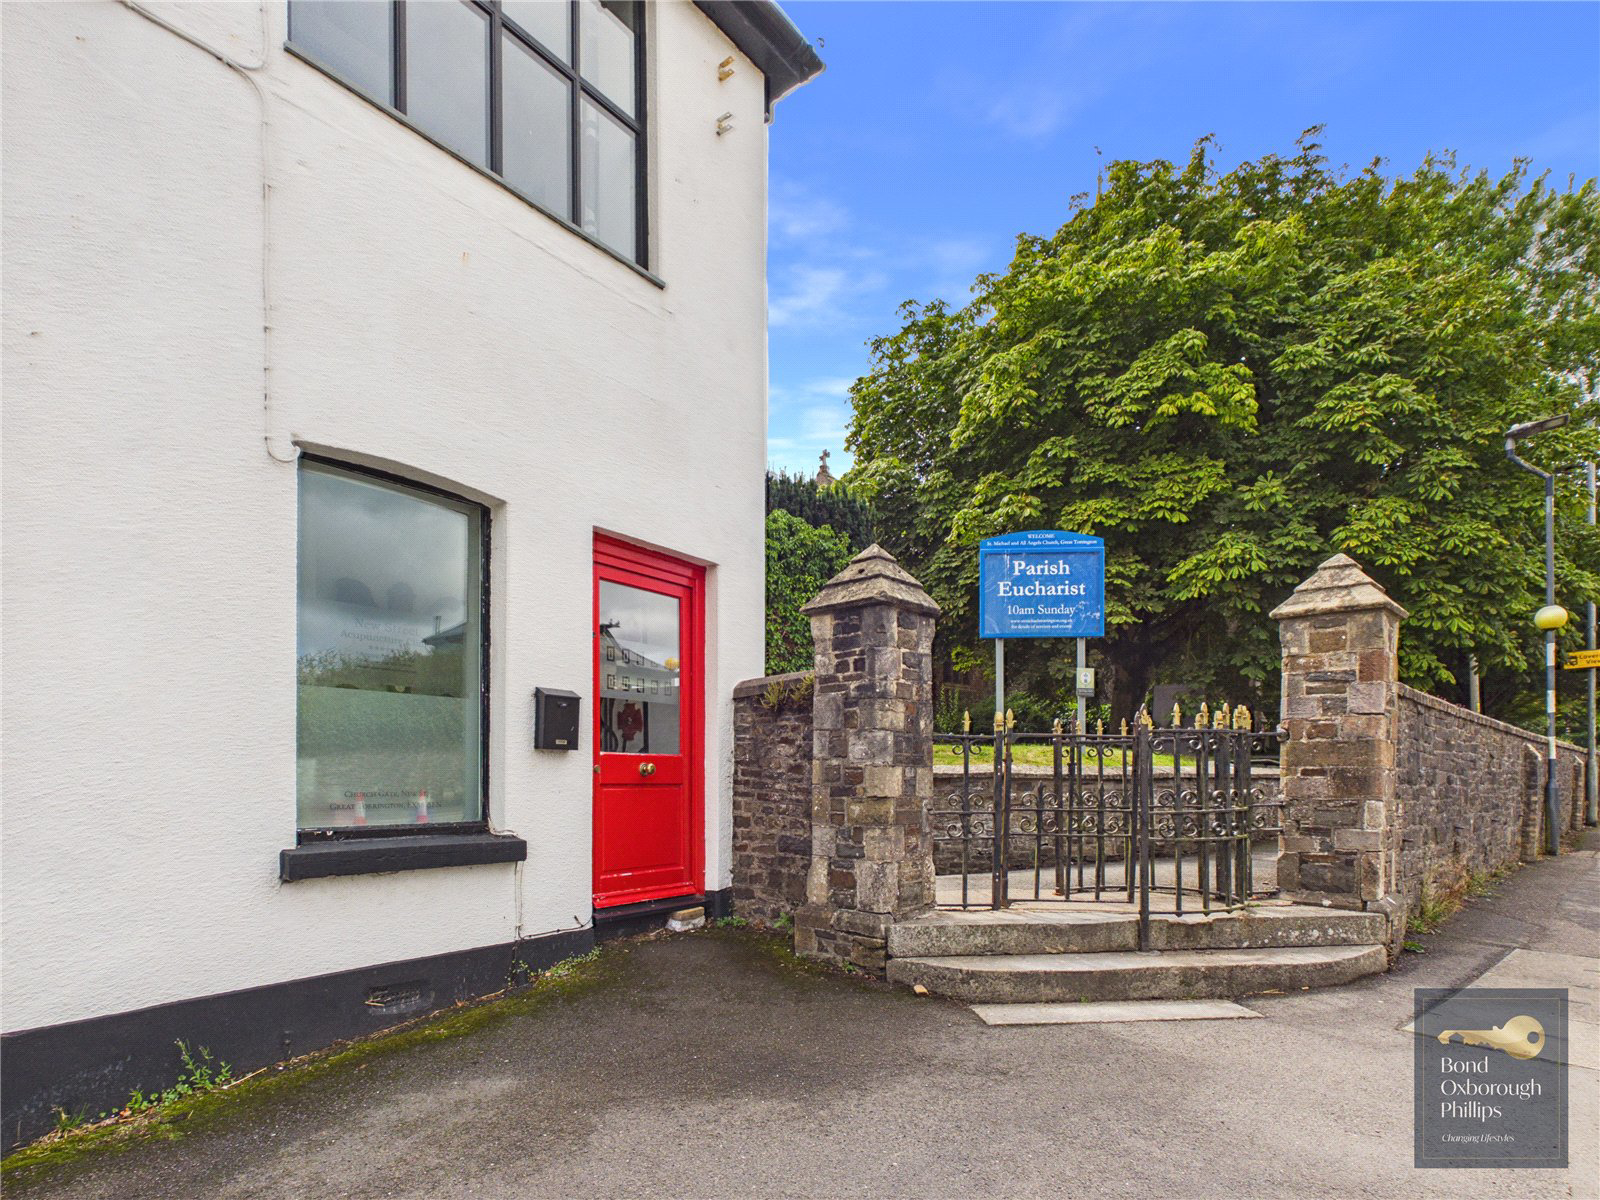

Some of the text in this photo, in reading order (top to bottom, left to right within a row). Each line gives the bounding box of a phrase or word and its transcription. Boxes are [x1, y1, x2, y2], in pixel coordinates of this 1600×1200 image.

[1012, 560, 1070, 576] Parish
[997, 580, 1086, 597] Eucharist
[1007, 604, 1076, 617] 10am Sunday
[357, 802, 405, 810] ORRINGTON,
